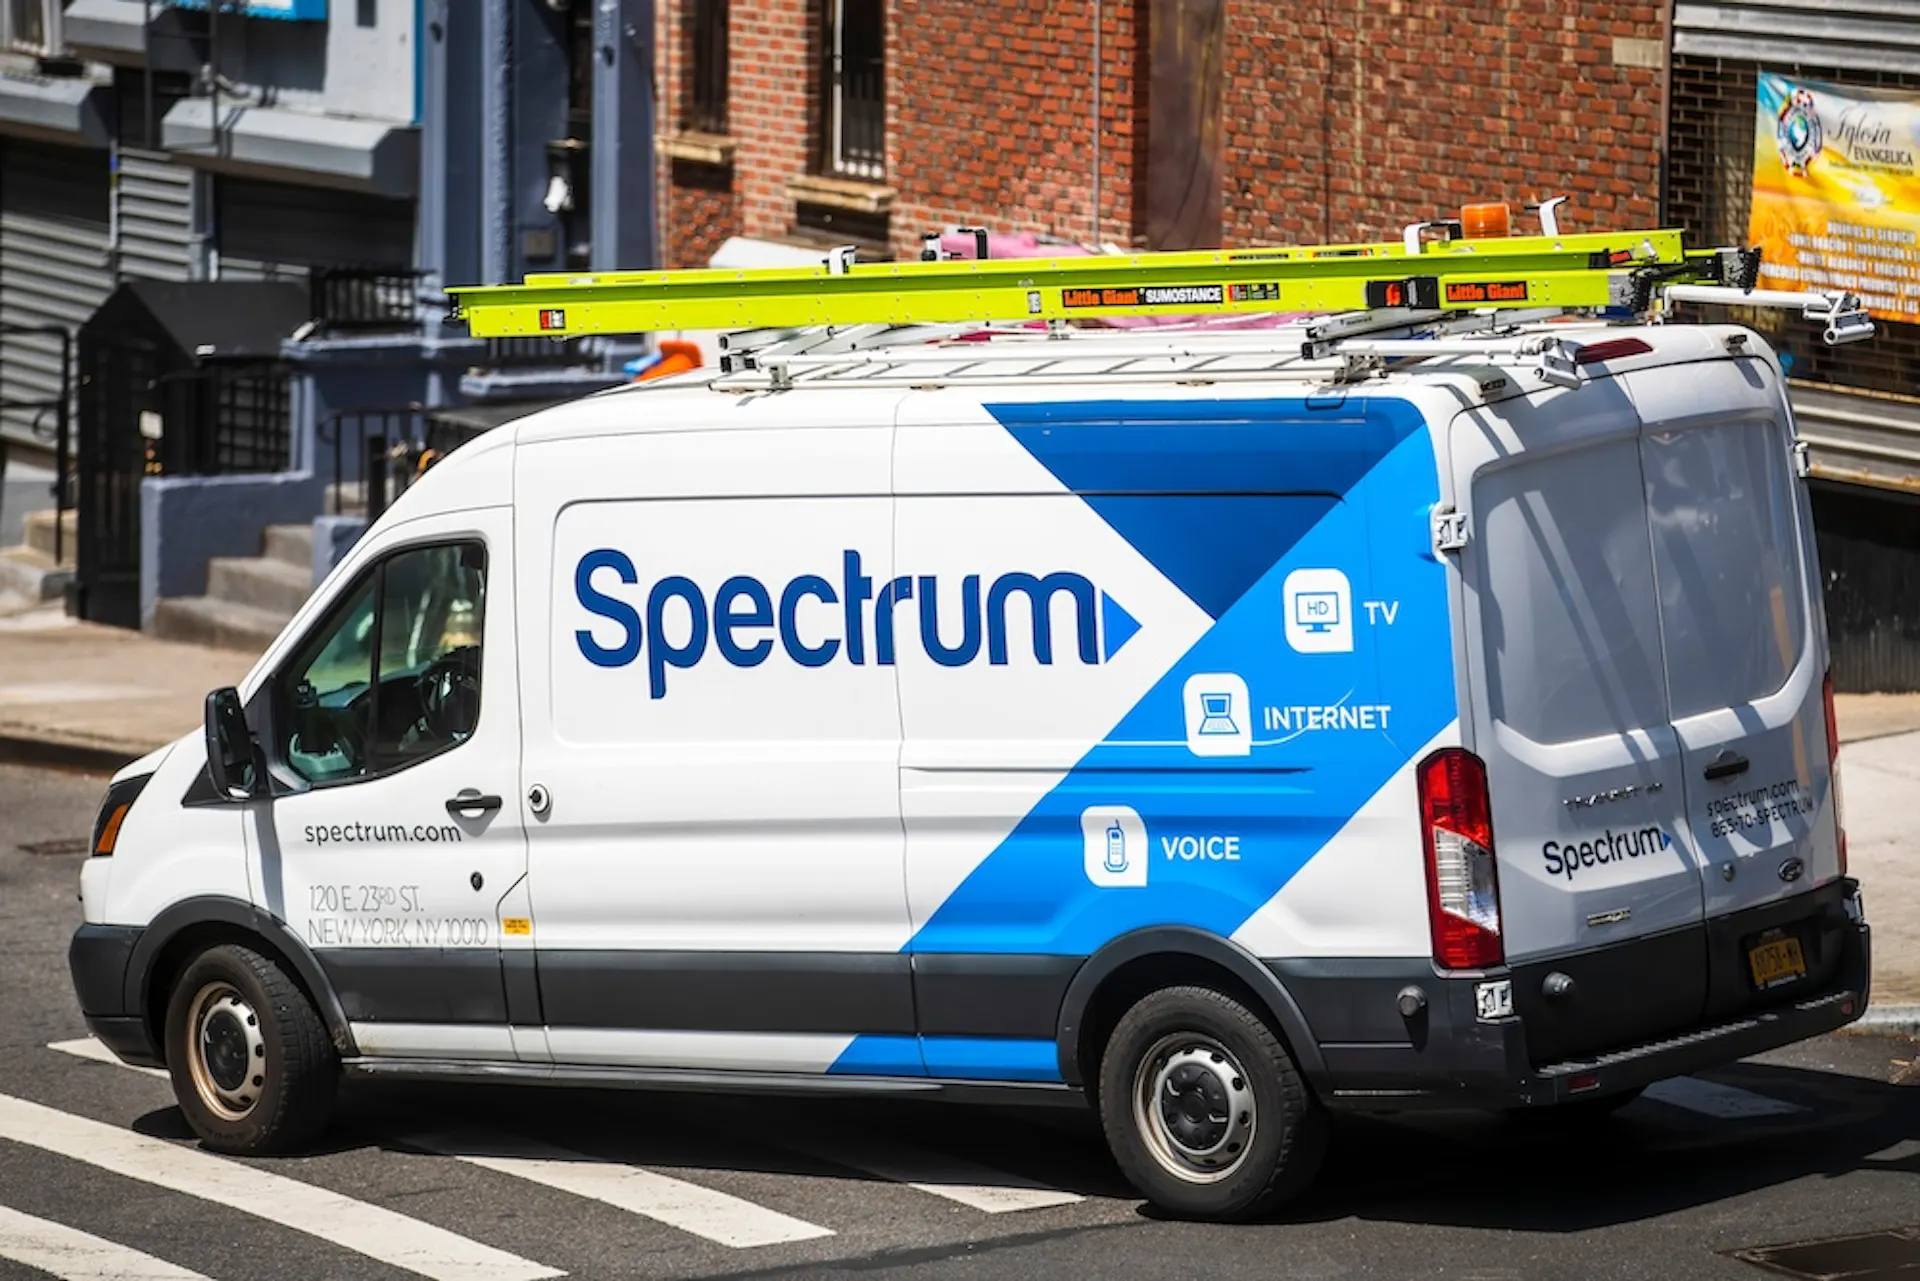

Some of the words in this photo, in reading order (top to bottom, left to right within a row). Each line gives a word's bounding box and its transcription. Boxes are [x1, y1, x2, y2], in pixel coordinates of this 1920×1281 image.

[1064, 290, 1100, 306] Little
[1146, 287, 1222, 303] SUMOSTANCE
[1447, 283, 1485, 300] Little
[1307, 600, 1329, 615] HD
[1363, 600, 1399, 625] TV
[575, 549, 1099, 699] Spectrum
[1264, 706, 1391, 730] INTERNET
[1707, 780, 1800, 817] spectrum.com
[304, 821, 462, 846] spectrum.com
[1161, 836, 1240, 860] VOICE
[1542, 827, 1665, 879] Spectrum
[309, 885, 338, 912] 120
[400, 885, 425, 912] ST.
[308, 918, 356, 944] NEW
[358, 918, 411, 948] YORK,
[416, 918, 441, 944] NY
[445, 918, 488, 945] 10010
